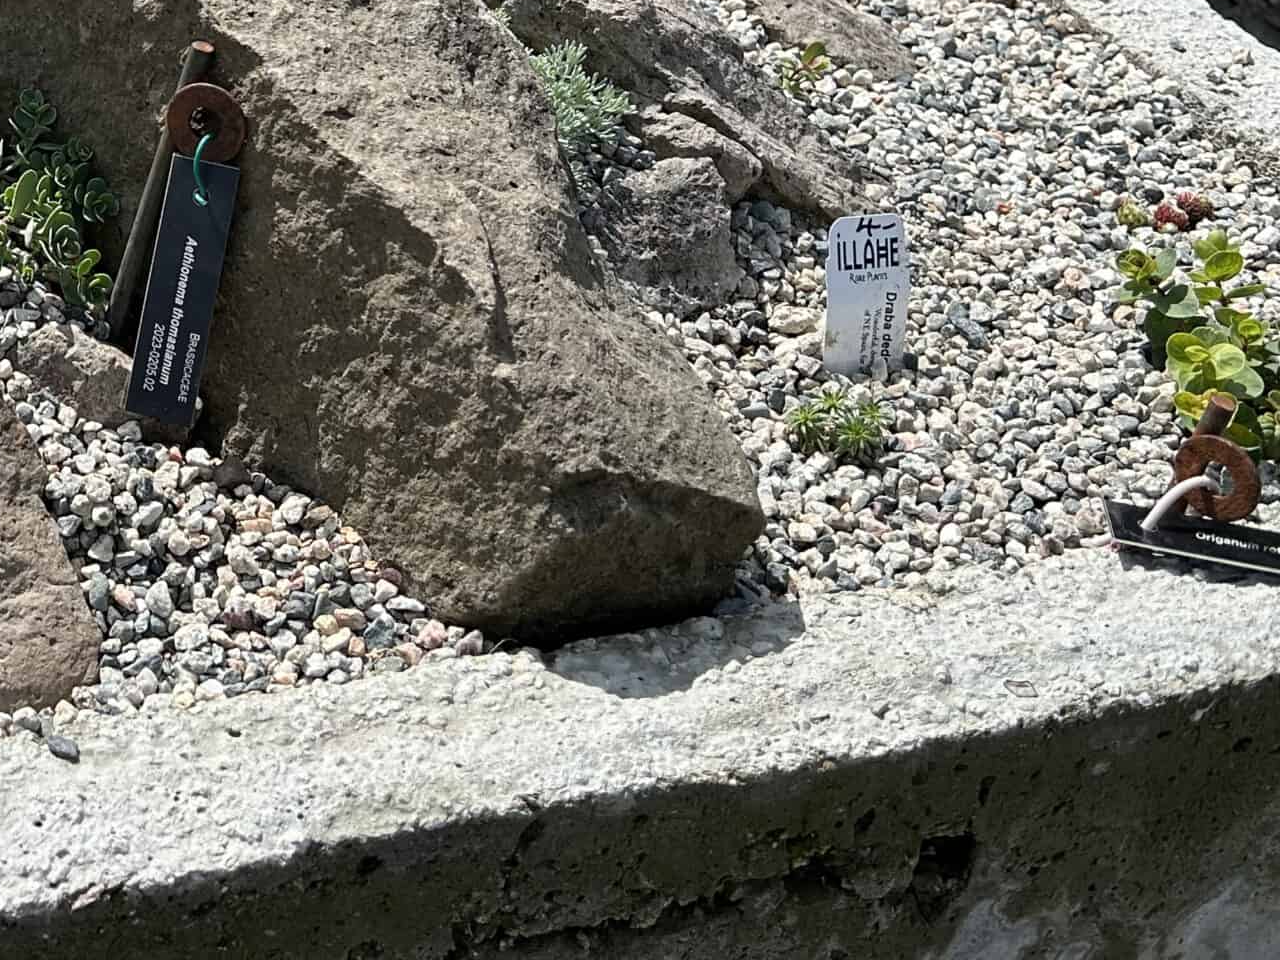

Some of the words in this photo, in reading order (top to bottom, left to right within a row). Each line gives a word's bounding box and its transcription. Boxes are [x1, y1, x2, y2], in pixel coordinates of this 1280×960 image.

[175, 235, 199, 305] Aethionema
[883, 291, 897, 330] Draba
[143, 322, 166, 392] 2023-0205.02
[160, 306, 184, 386] thomasianum
[177, 333, 201, 404] BRASSICACEAE
[1195, 530, 1260, 550] Origanum
